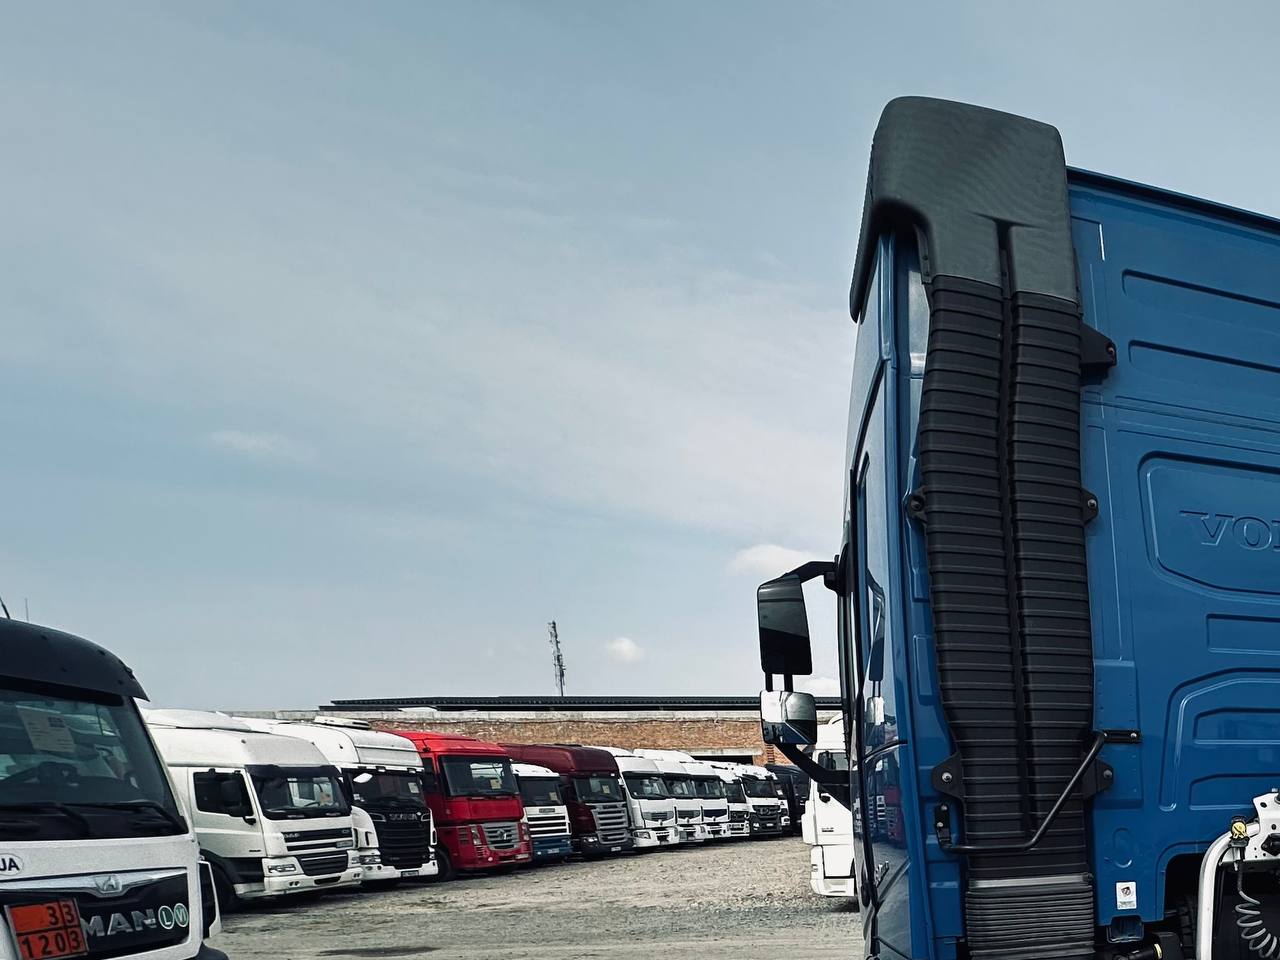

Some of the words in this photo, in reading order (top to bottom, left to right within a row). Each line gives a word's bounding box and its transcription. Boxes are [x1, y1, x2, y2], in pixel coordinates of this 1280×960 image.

[47, 903, 75, 926] 33
[80, 909, 157, 937] MAN
[22, 931, 82, 959] 1203
